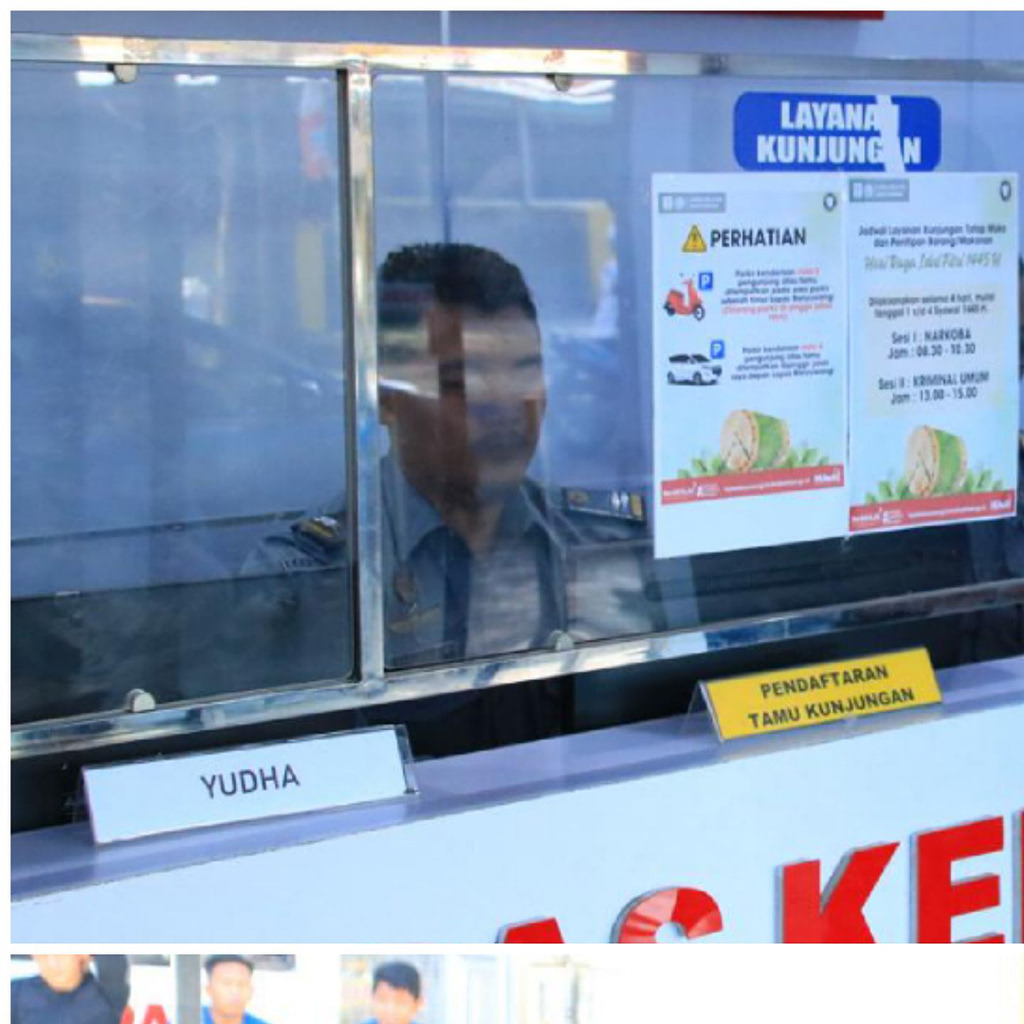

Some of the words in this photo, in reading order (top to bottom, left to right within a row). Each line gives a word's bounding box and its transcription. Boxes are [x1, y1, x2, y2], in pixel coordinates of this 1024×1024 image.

[757, 134, 921, 163] KUNJUNGN
[710, 227, 806, 247] PERHATIAN
[891, 332, 910, 344] Sesi
[924, 328, 972, 341] NARKOBA
[888, 347, 909, 360] Jam
[913, 373, 957, 387] KRIMINAL
[960, 370, 990, 384] UMUM
[760, 664, 889, 699] PENDAFTARAN
[748, 707, 800, 729] TAMU
[805, 688, 914, 719] KUNJUNGAN
[200, 763, 300, 799] YUDHA
